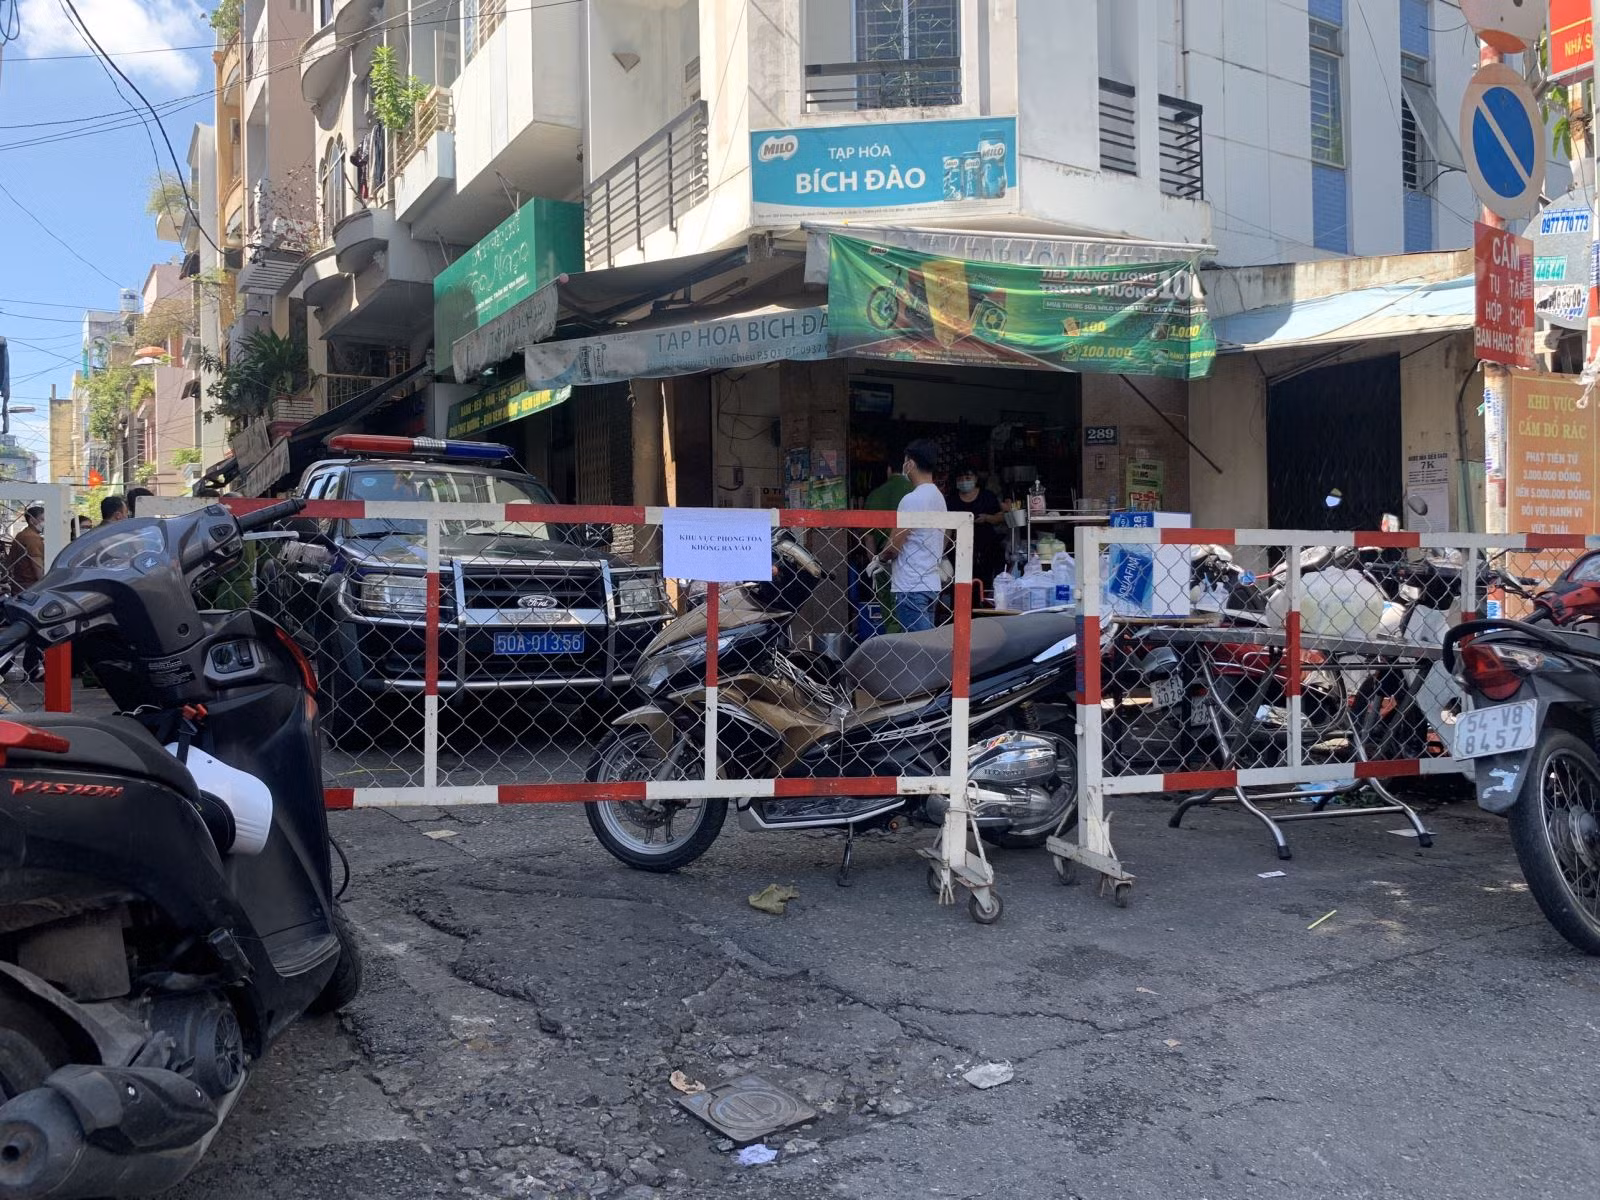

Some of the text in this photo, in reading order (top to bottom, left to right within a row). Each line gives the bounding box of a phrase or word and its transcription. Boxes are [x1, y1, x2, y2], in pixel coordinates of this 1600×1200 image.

[763, 141, 795, 156] MILO
[828, 143, 892, 162] TẠP HÓA
[982, 147, 1004, 158] MILO
[796, 164, 926, 194] BÍCH ĐÀO
[1493, 234, 1520, 271] CẤM
[1489, 273, 1500, 298] TỤ
[748, 315, 795, 341] BÍCH
[1475, 323, 1491, 348] BÁN
[1492, 326, 1513, 354] HÀNG
[1528, 394, 1550, 409] KHU
[1088, 428, 1114, 439] 289
[1563, 420, 1587, 439] RÁC
[1118, 556, 1141, 600] AQUAFINA
[527, 598, 549, 607] Ford
[1465, 727, 1522, 755] 8457
[8, 778, 124, 798] VISION
